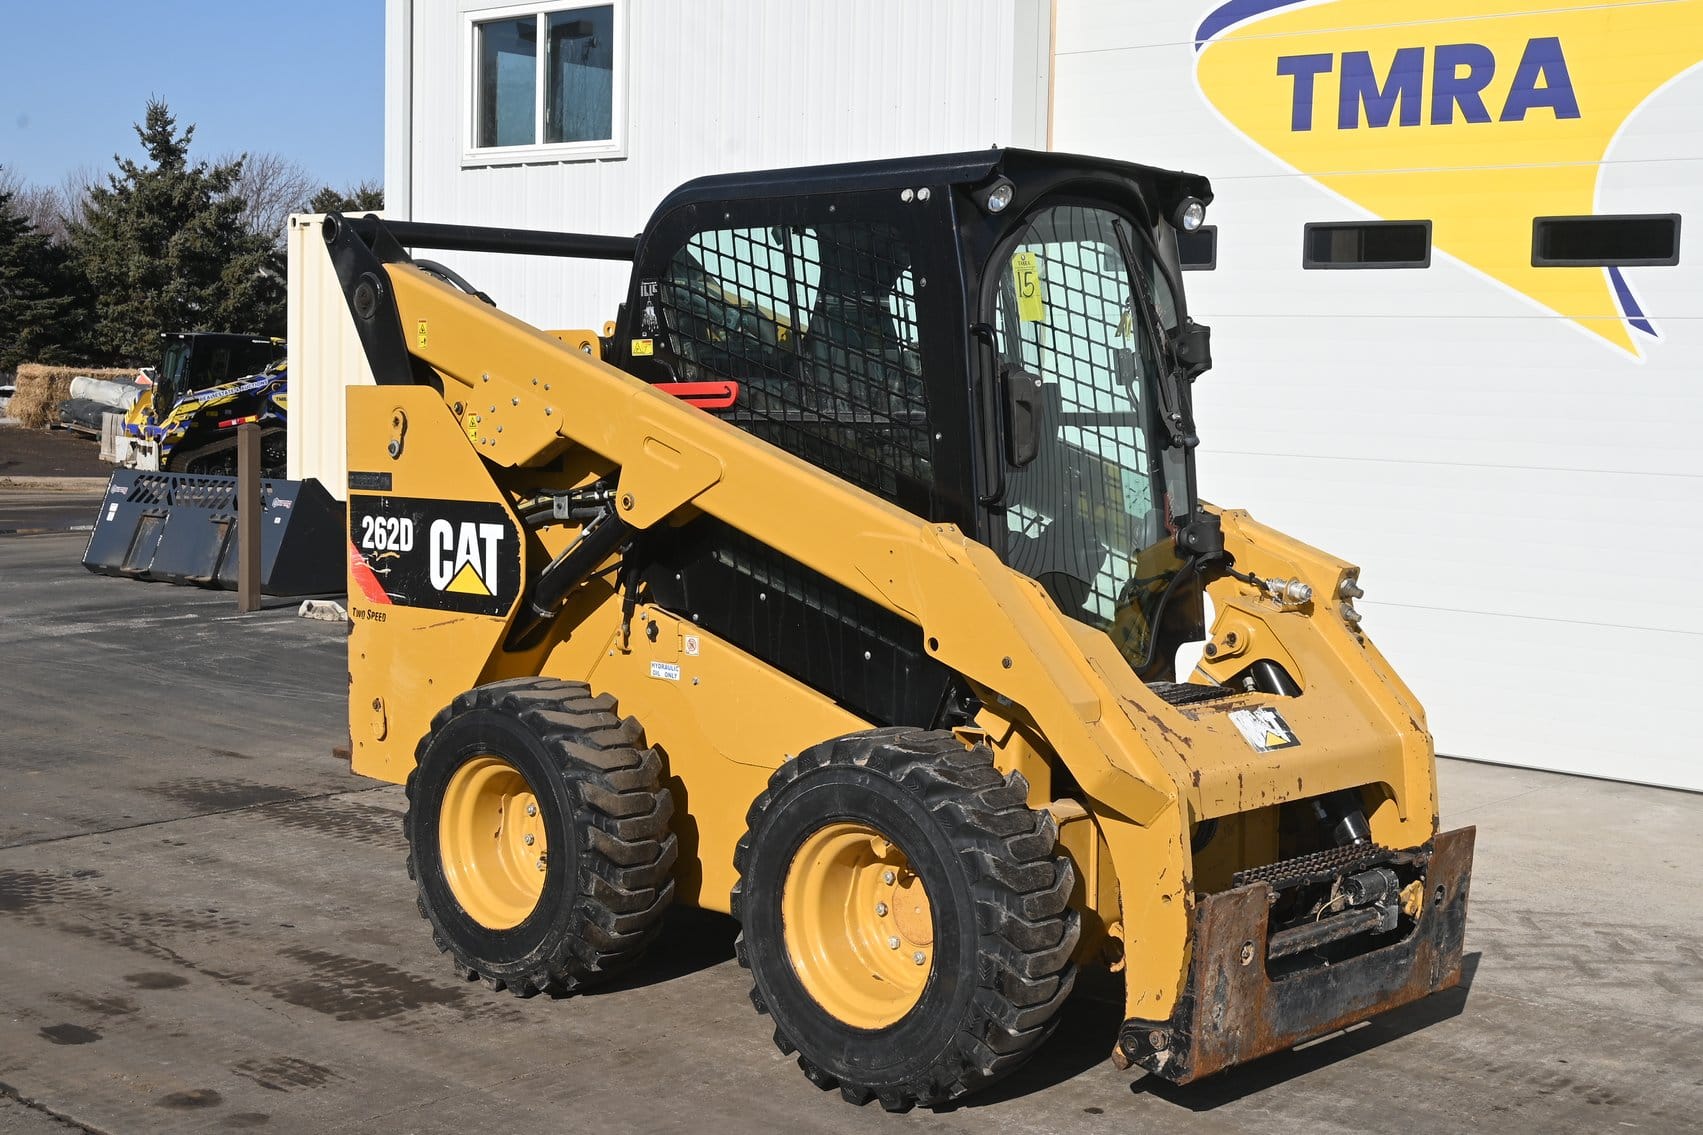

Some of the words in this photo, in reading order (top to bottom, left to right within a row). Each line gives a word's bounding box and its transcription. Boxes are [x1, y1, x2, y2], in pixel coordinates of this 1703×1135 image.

[1276, 36, 1582, 132] TMRA
[1017, 271, 1035, 298] 15
[362, 515, 413, 551] 262D
[430, 519, 504, 596] CAT
[652, 663, 679, 672] HYDRAULIC
